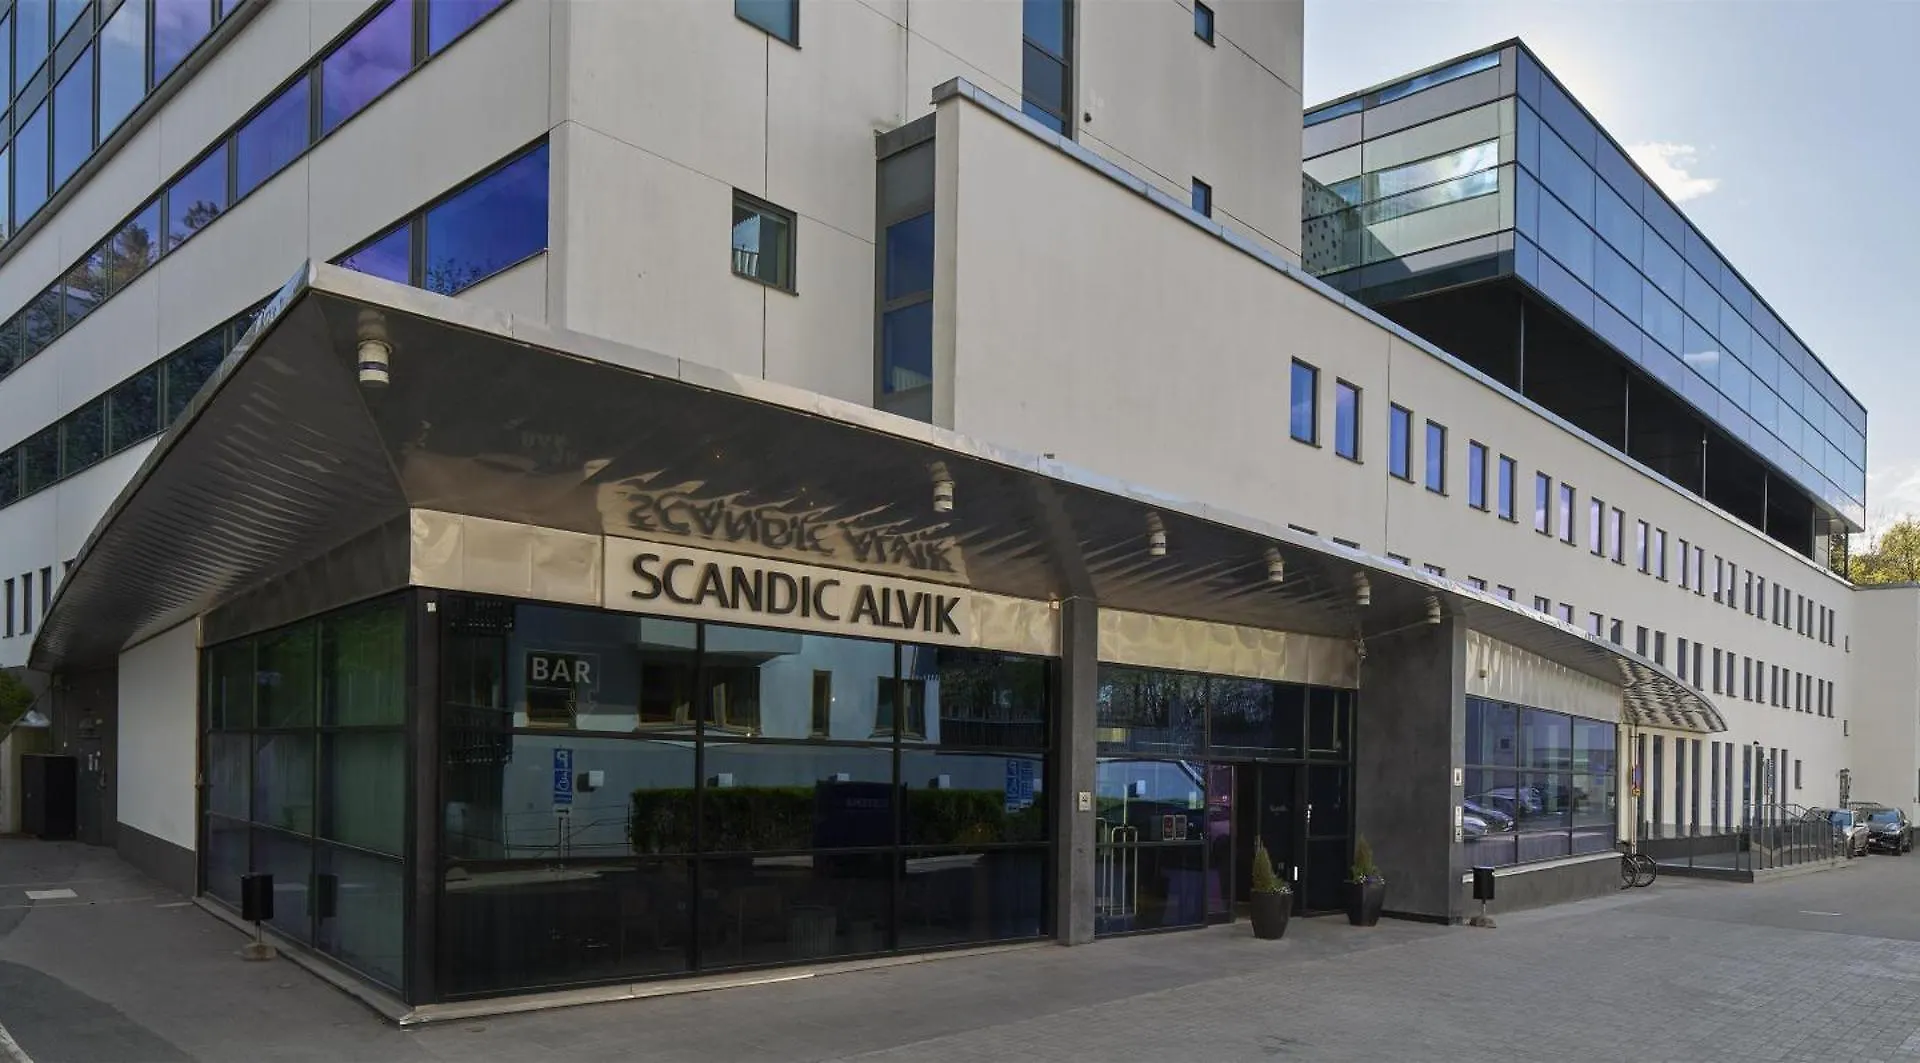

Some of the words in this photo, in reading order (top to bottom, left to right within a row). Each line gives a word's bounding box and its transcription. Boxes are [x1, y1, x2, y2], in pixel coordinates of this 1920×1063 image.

[631, 552, 841, 622] SCANDIC
[850, 584, 961, 636] ALVIK
[532, 656, 591, 684] BAR
